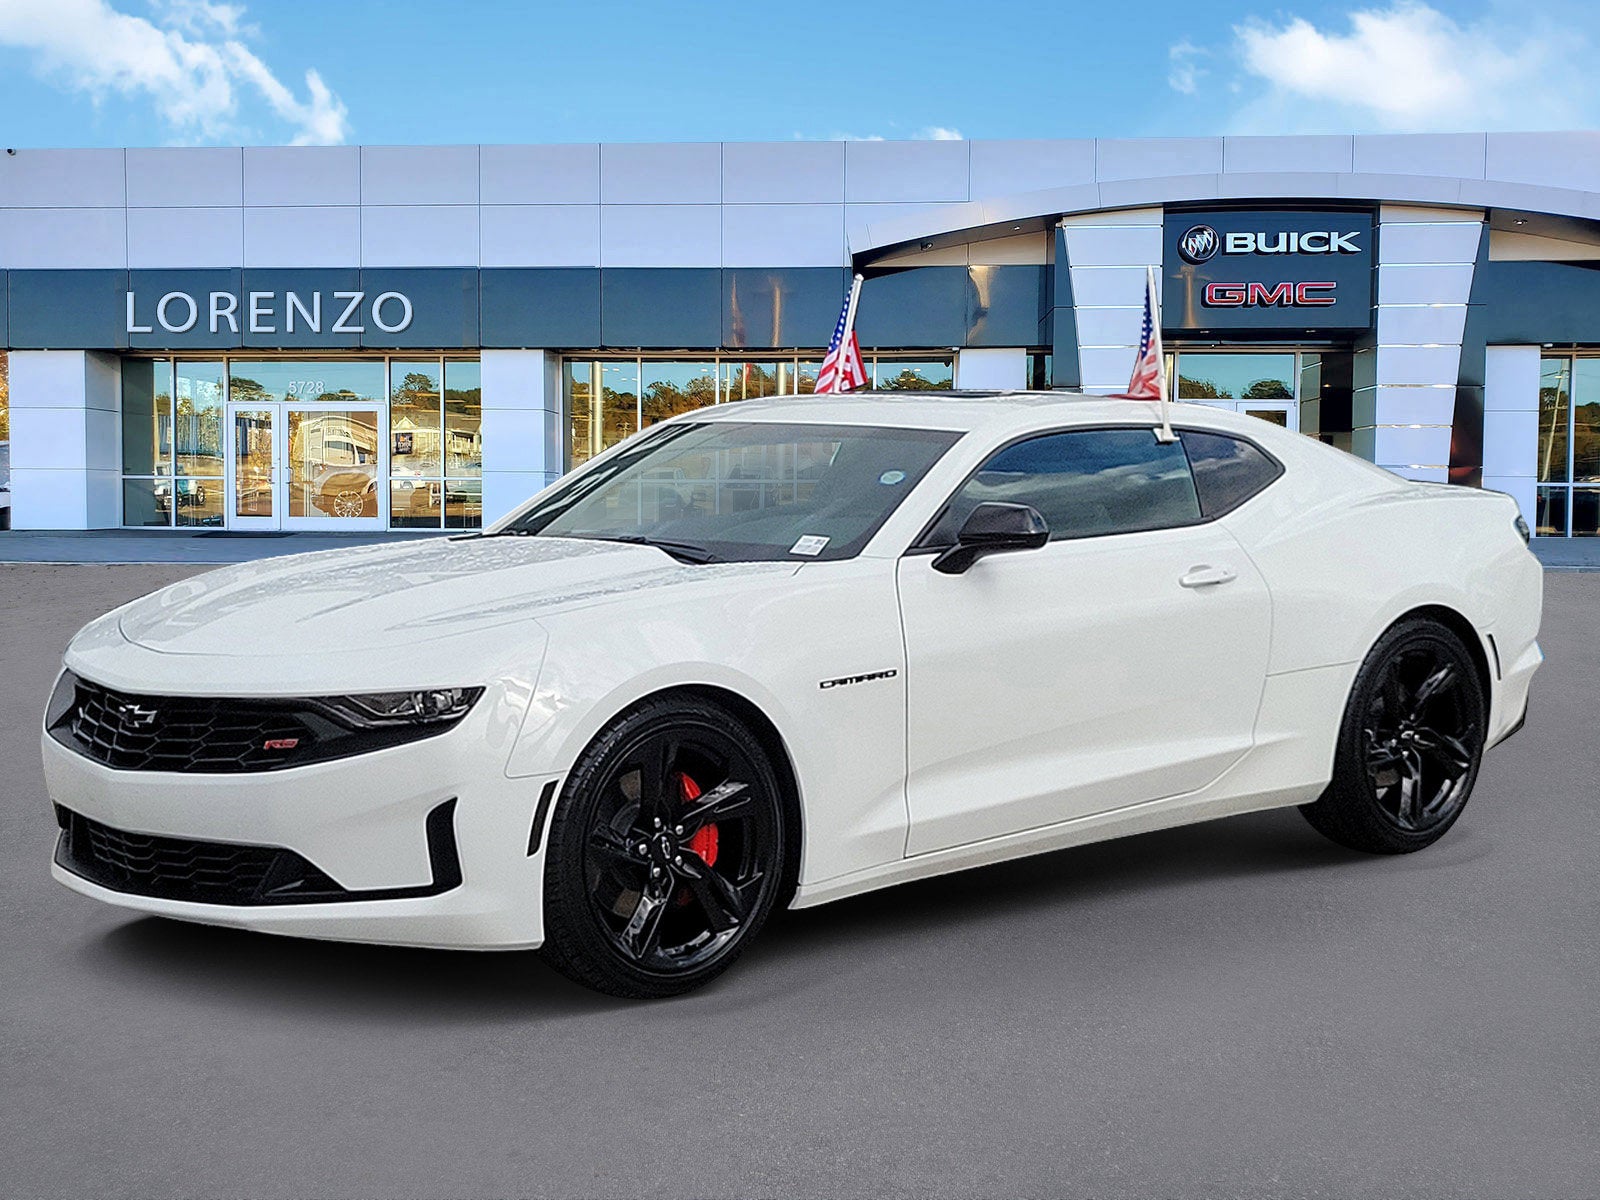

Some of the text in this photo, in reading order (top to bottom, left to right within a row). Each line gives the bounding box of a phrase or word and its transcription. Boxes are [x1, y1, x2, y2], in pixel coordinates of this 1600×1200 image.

[1225, 231, 1362, 253] BUICK
[1206, 281, 1337, 305] GMC
[126, 291, 413, 333] LORENZO
[288, 381, 325, 394] 5728
[819, 669, 898, 689] CAMARO
[263, 738, 299, 750] RS
